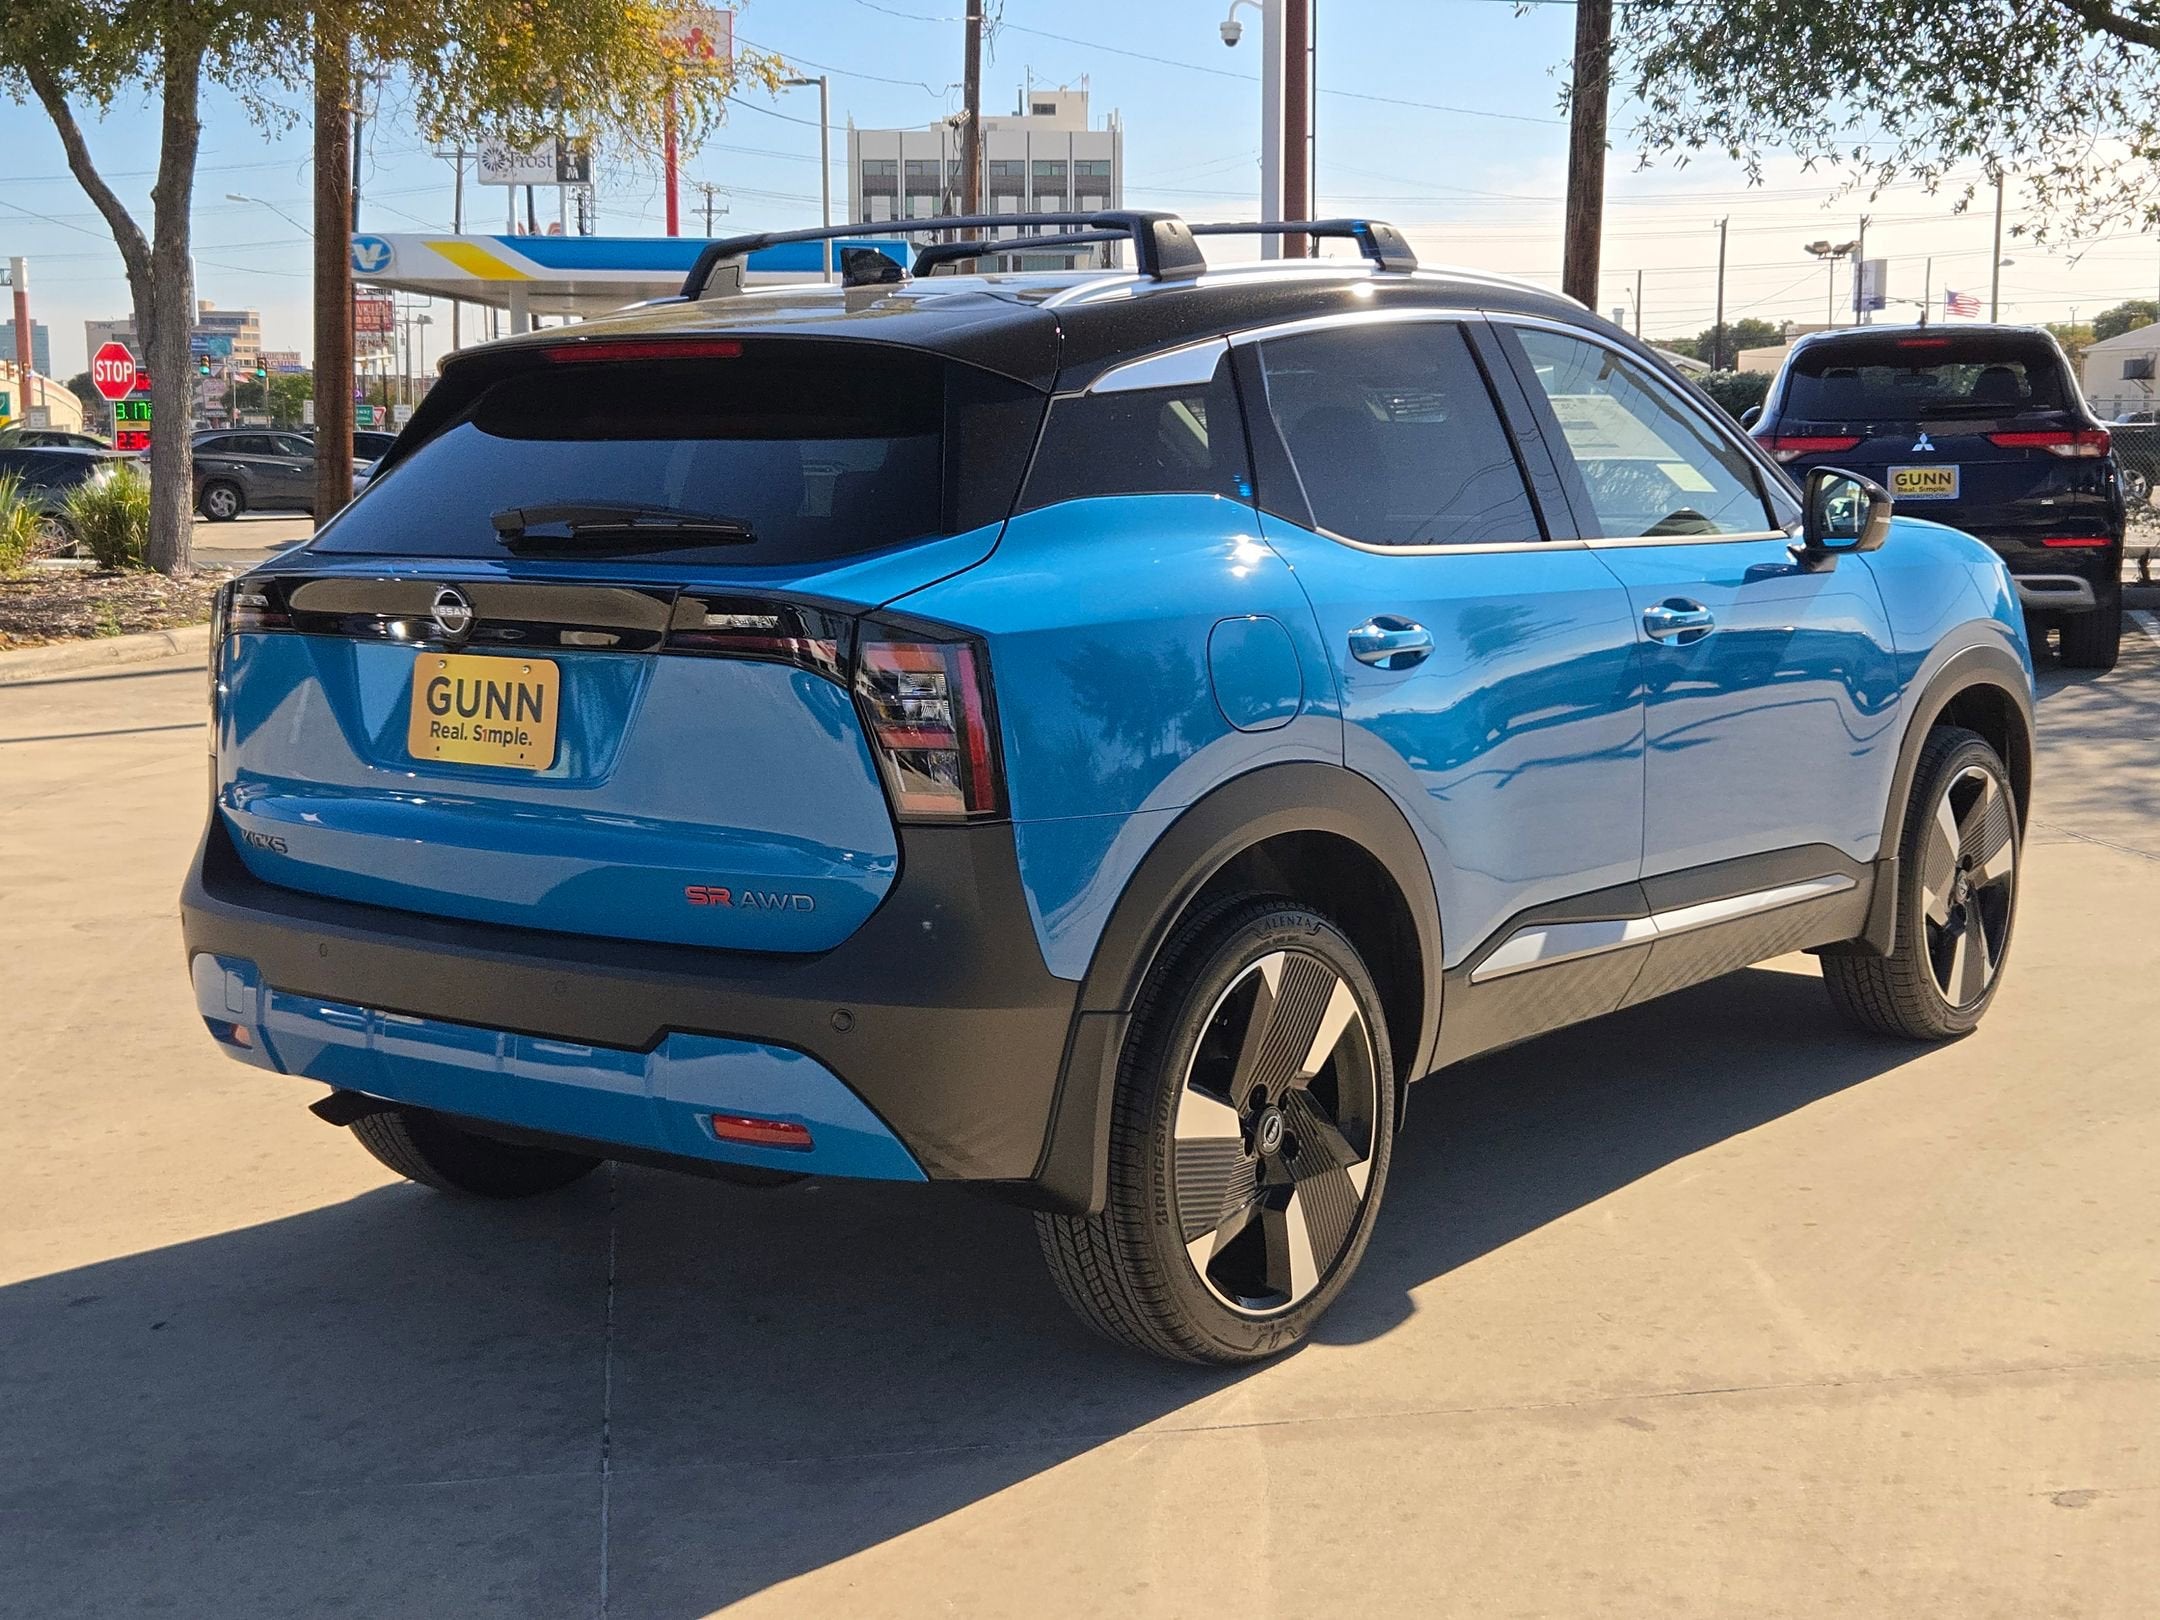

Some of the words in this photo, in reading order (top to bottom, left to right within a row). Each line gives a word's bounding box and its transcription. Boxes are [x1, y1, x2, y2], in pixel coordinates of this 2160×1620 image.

[95, 361, 133, 382] STOP
[1895, 472, 1952, 486] GUNN
[431, 606, 472, 617] NISSAN
[426, 676, 544, 723] GUNN
[430, 720, 467, 741] Real.
[241, 830, 288, 854] KICKS
[685, 885, 735, 907] SR
[741, 891, 816, 912] AWD
[1264, 915, 1312, 930] ALENZA
